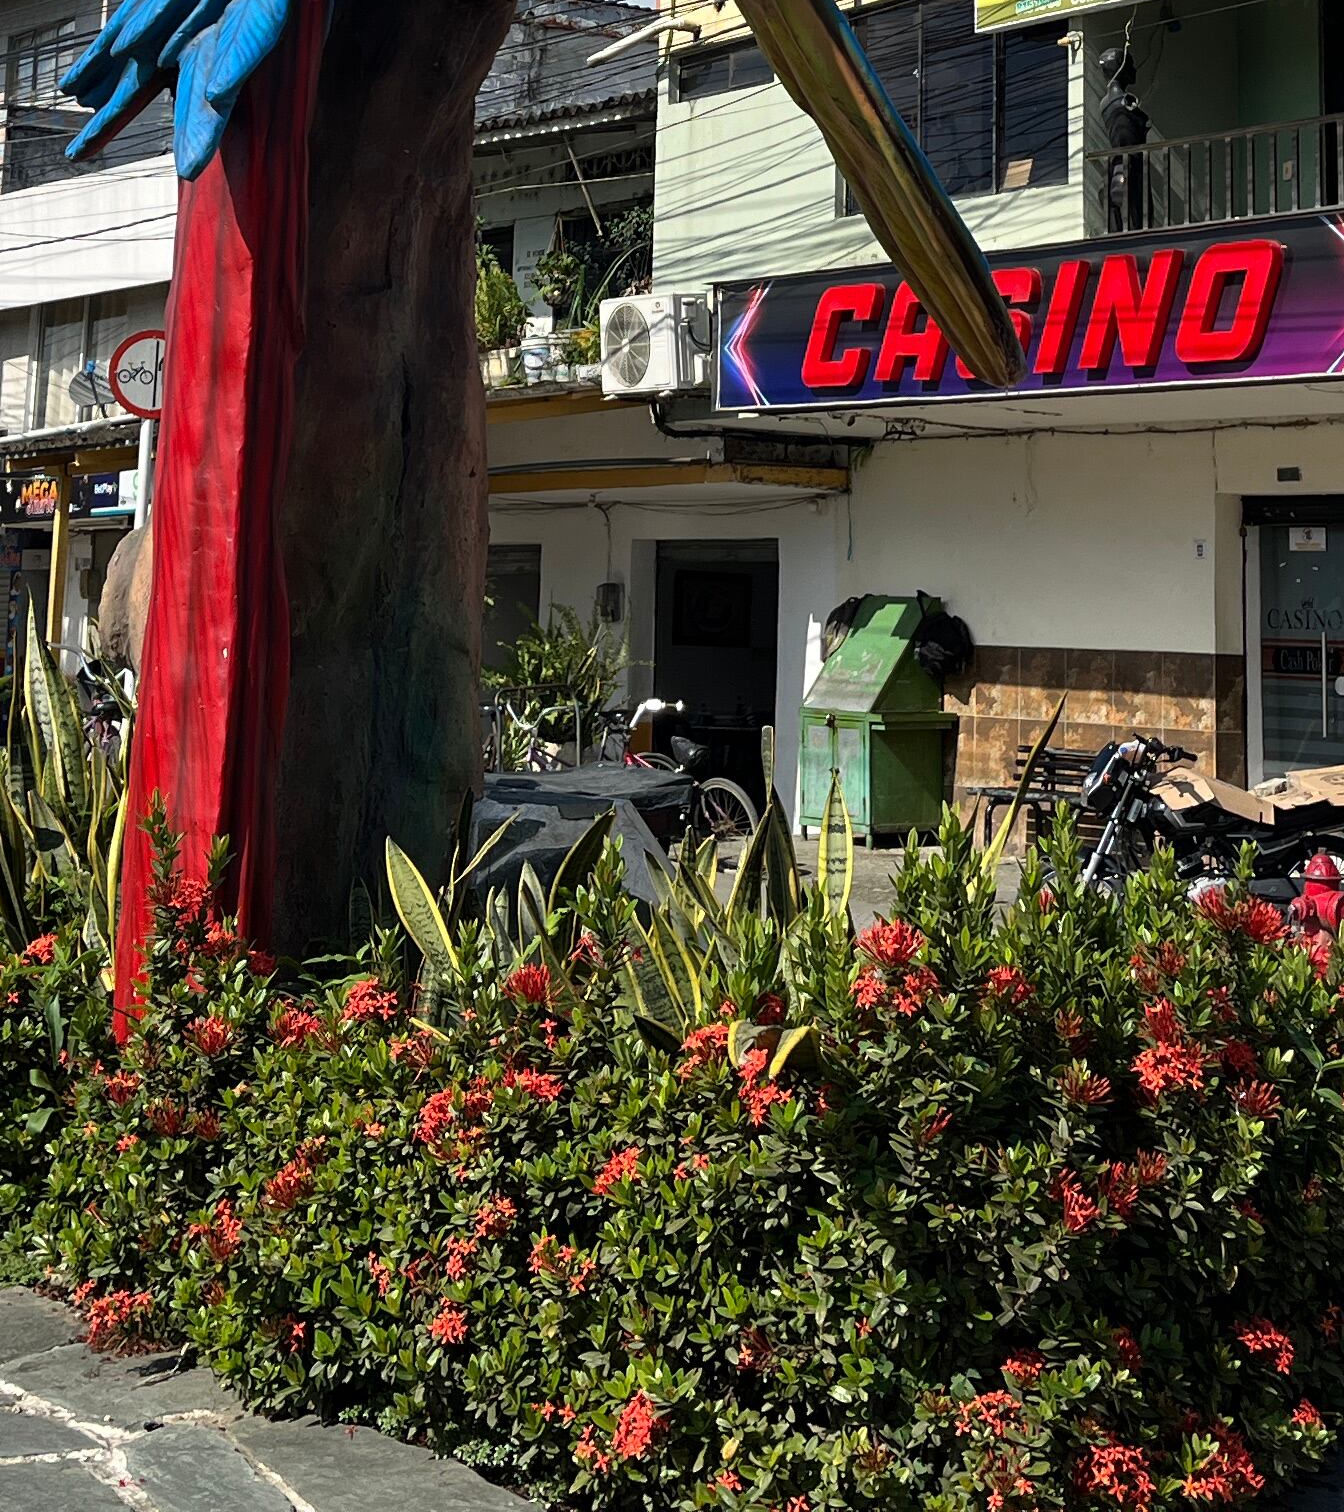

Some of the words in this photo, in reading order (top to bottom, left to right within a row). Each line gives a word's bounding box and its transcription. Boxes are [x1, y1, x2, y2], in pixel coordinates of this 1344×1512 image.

[1267, 608, 1344, 630] CASINO
[1280, 649, 1304, 670] Cash
[1306, 651, 1335, 673] Pokr
